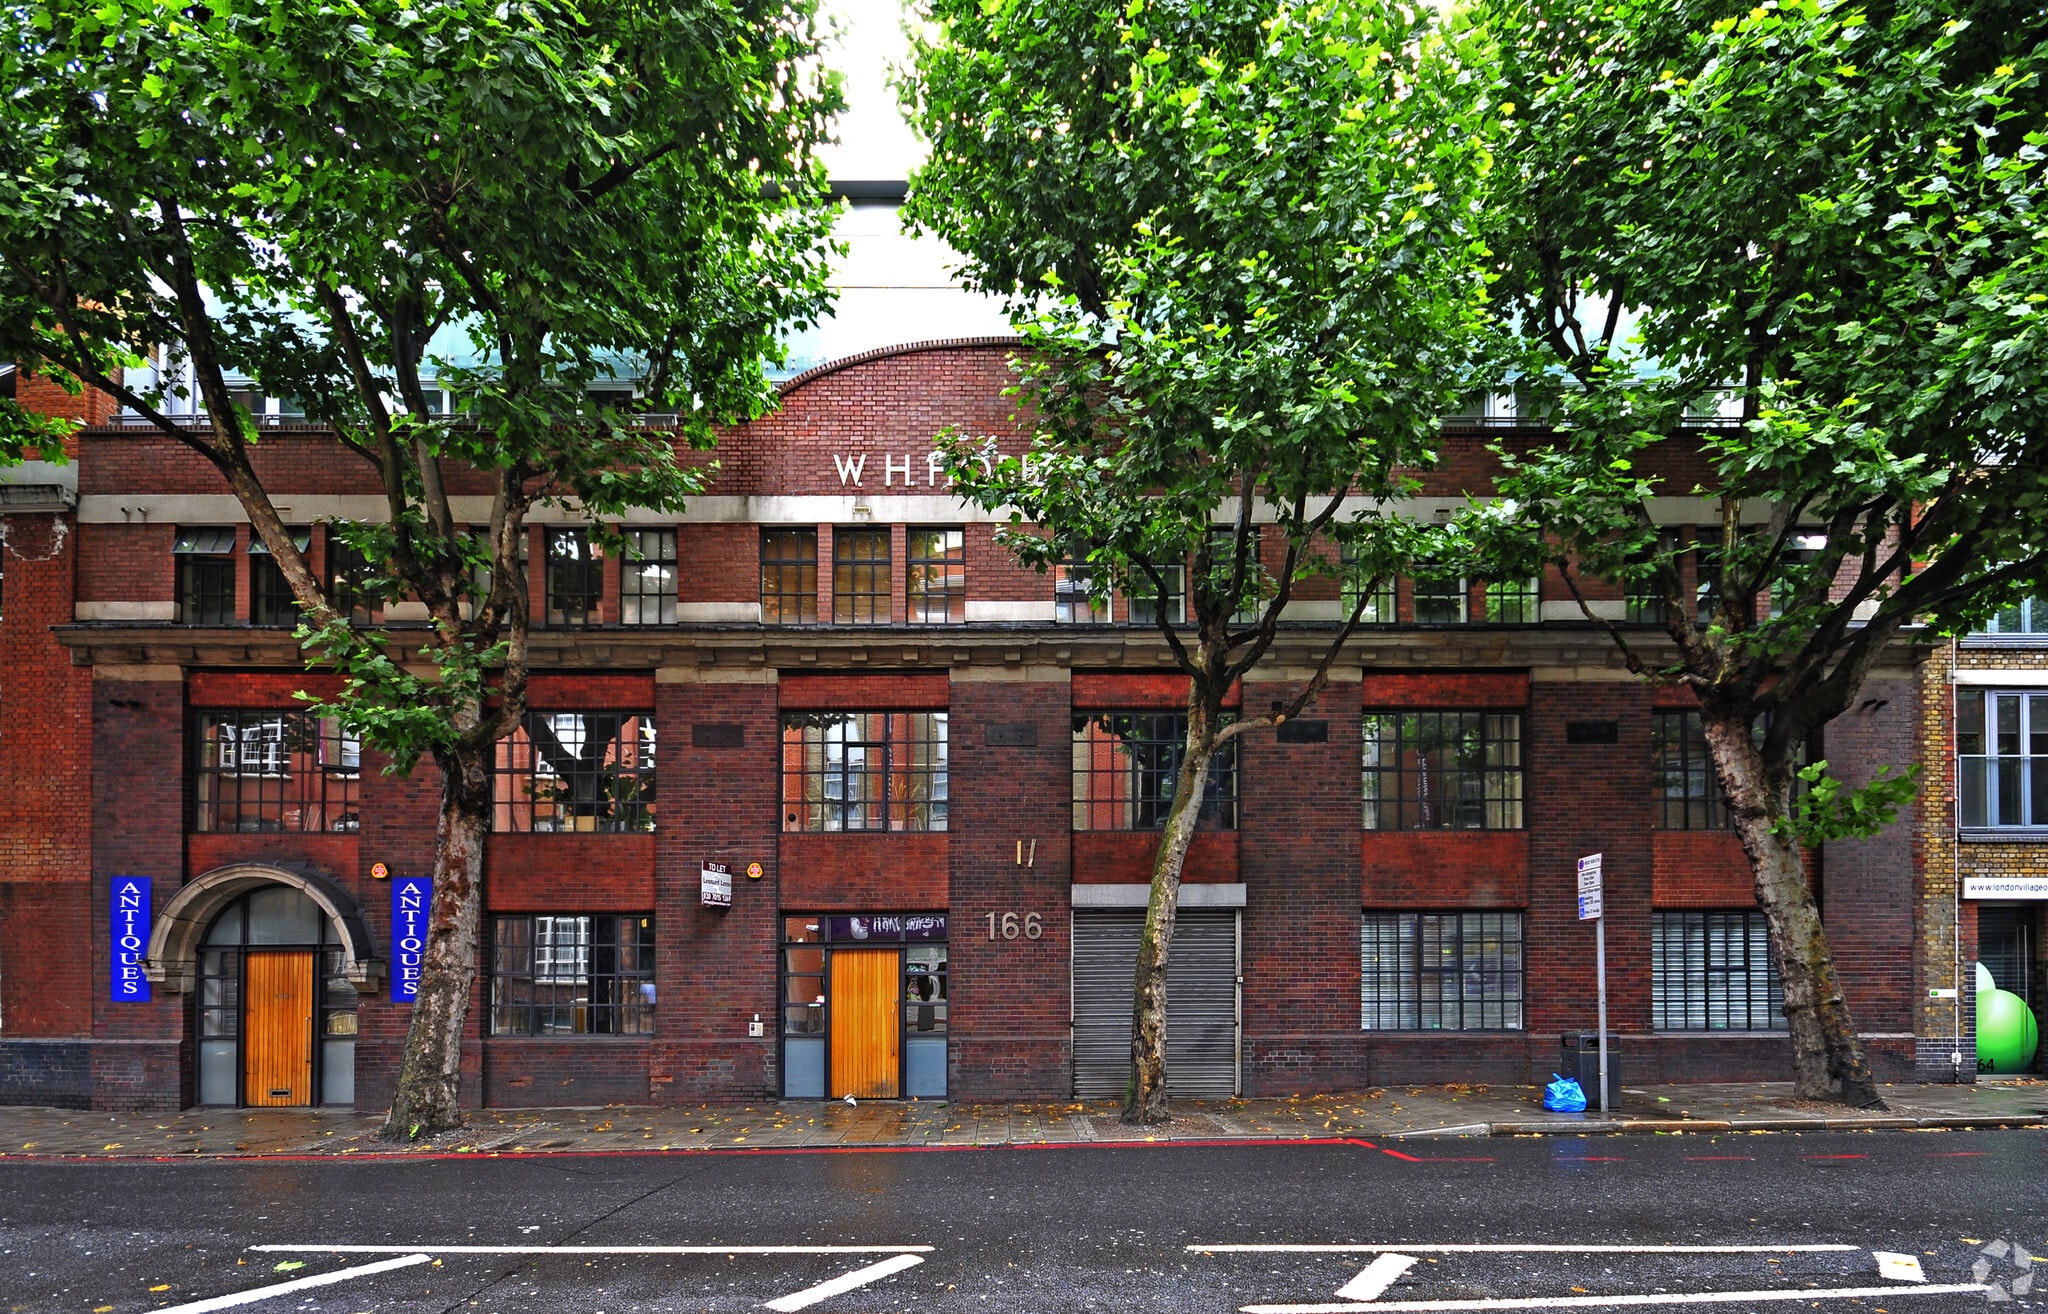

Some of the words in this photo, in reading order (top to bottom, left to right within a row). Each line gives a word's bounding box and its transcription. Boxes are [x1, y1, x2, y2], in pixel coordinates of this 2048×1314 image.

[833, 454, 866, 487] W.
[885, 454, 915, 486] H.
[119, 882, 141, 994] ANTIQUES
[400, 882, 422, 995] ANTIQUES
[985, 911, 1042, 940] 166
